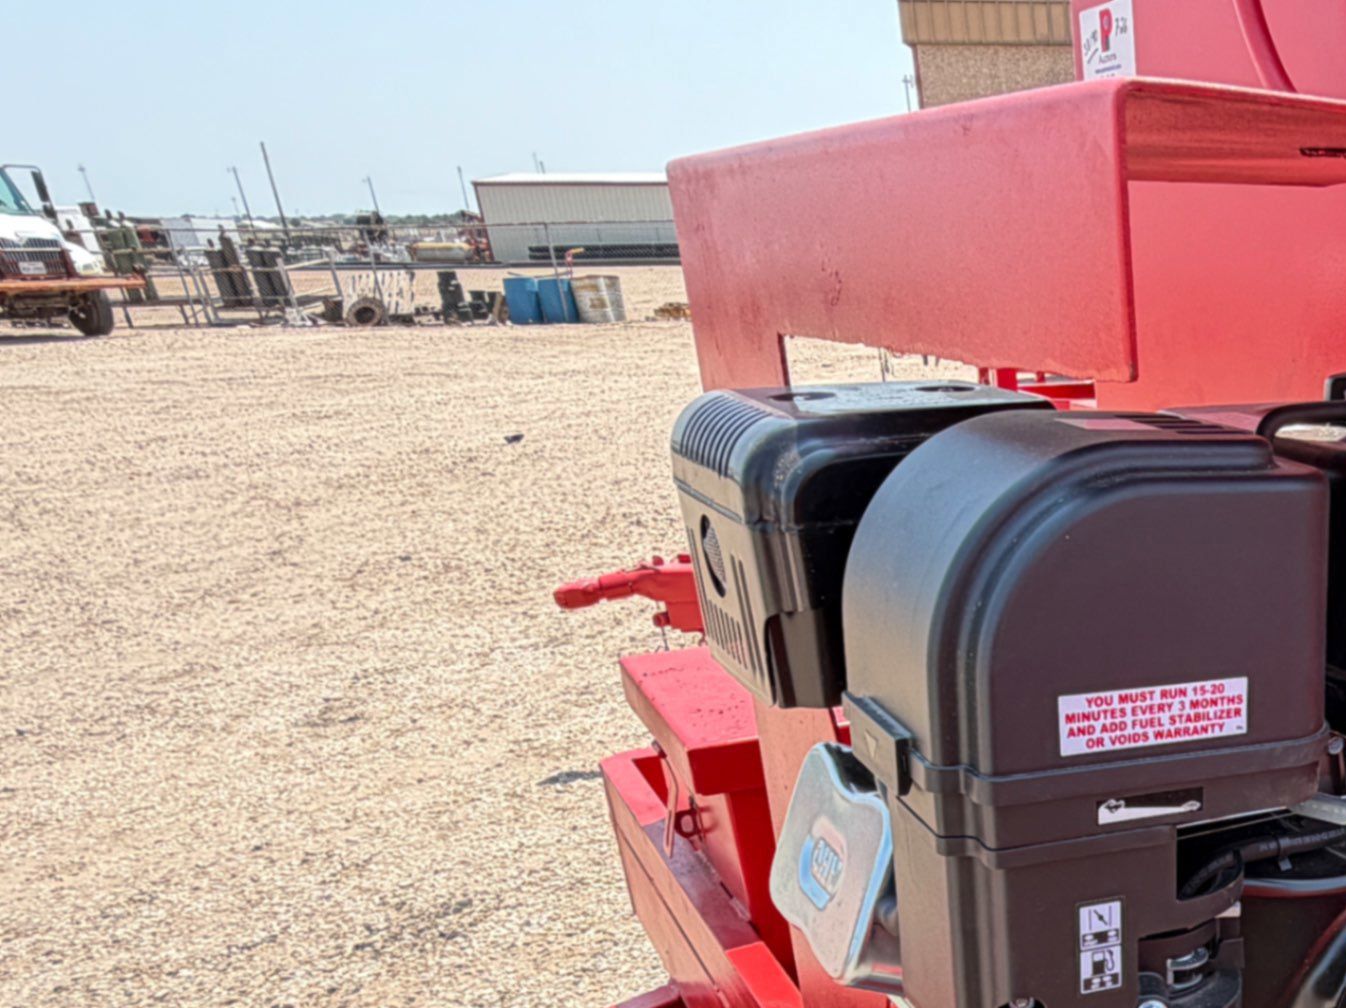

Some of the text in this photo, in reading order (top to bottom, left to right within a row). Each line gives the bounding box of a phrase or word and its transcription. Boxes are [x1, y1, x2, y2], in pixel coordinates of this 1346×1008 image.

[1065, 694, 1244, 725] MINUTES EVERY 3 MONTHS
[1086, 683, 1225, 709] YOU MUST RUN 15-20
[1067, 707, 1242, 739] AND ADD FUEL STABILIZER
[1086, 722, 1226, 749] OR VOIDS WARRANTY
